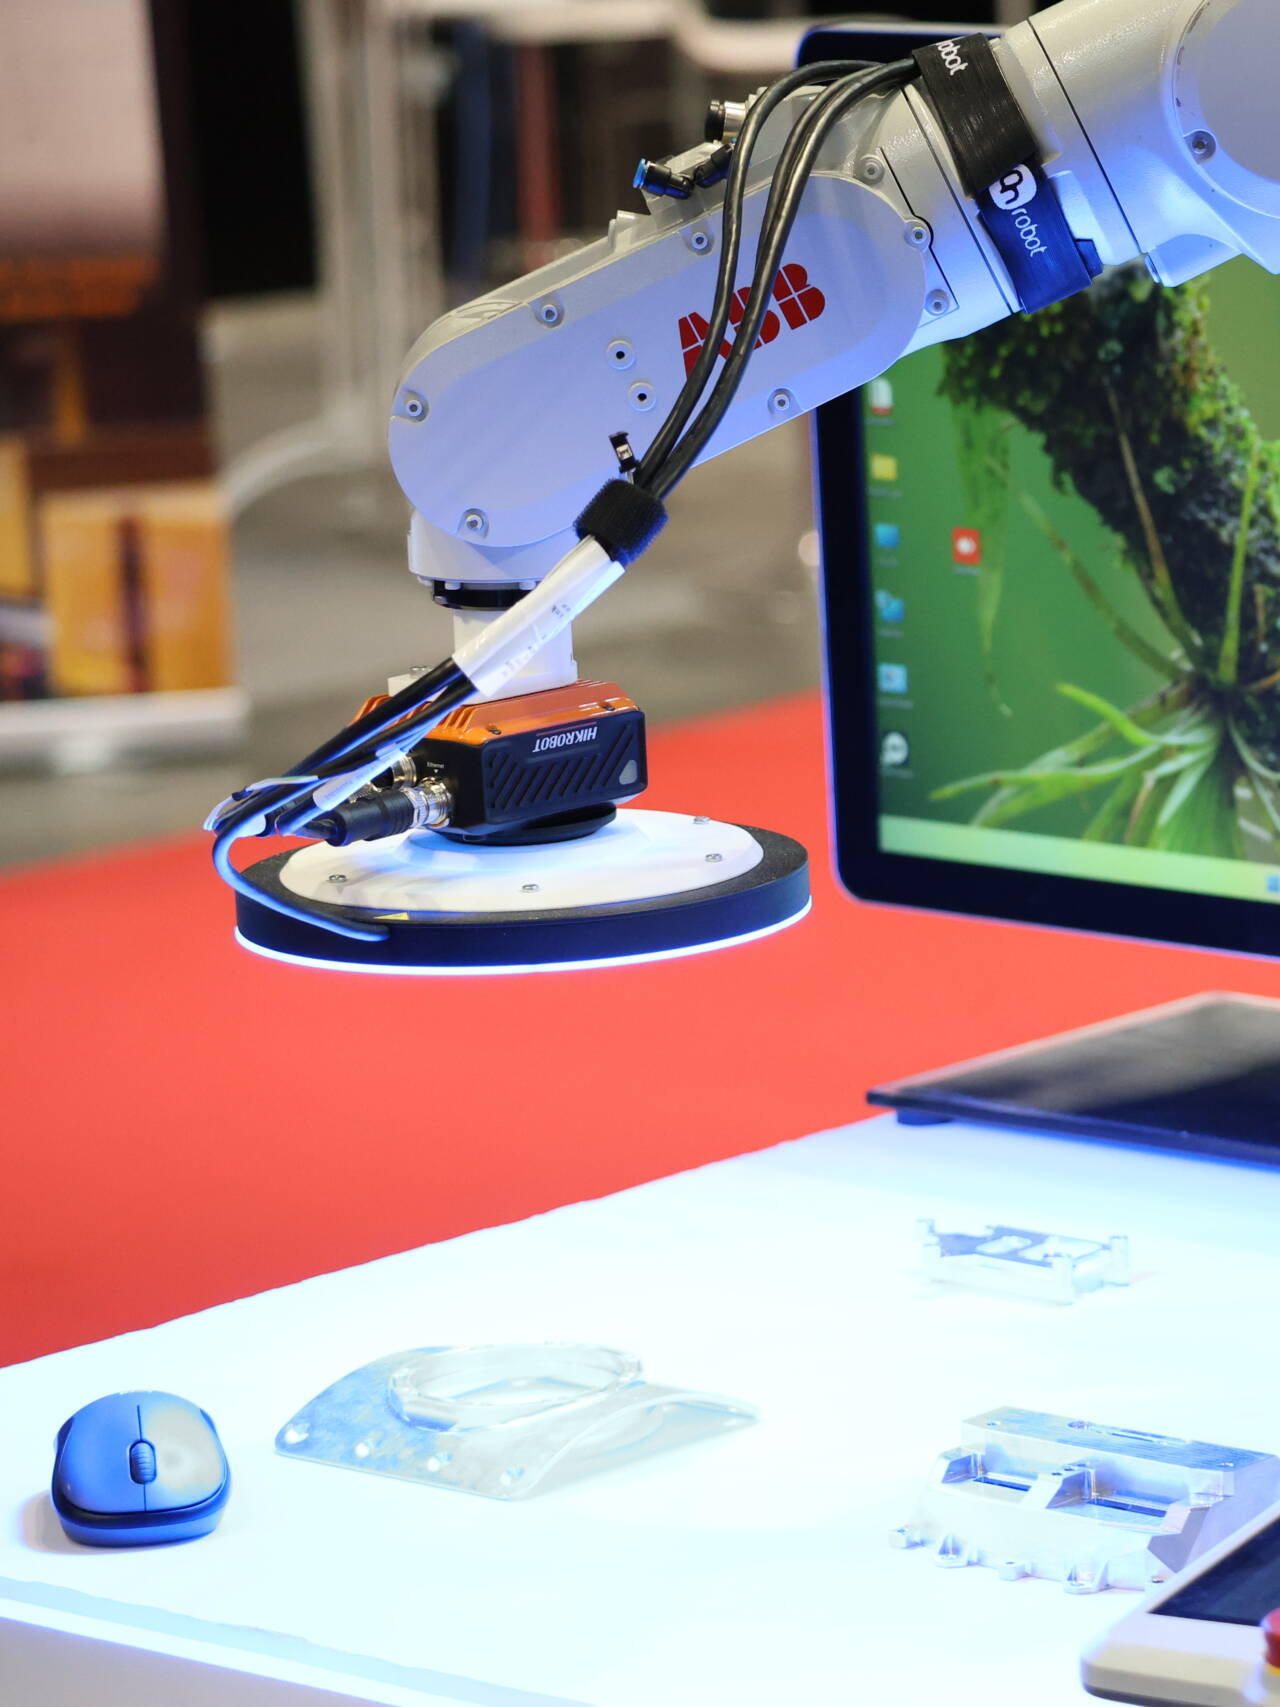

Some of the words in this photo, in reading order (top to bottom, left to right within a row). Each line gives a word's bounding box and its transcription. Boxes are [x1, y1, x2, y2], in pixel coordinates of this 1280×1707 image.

[936, 39, 969, 76] obot
[1011, 208, 1048, 257] robot
[532, 726, 598, 753] HIKROBOT
